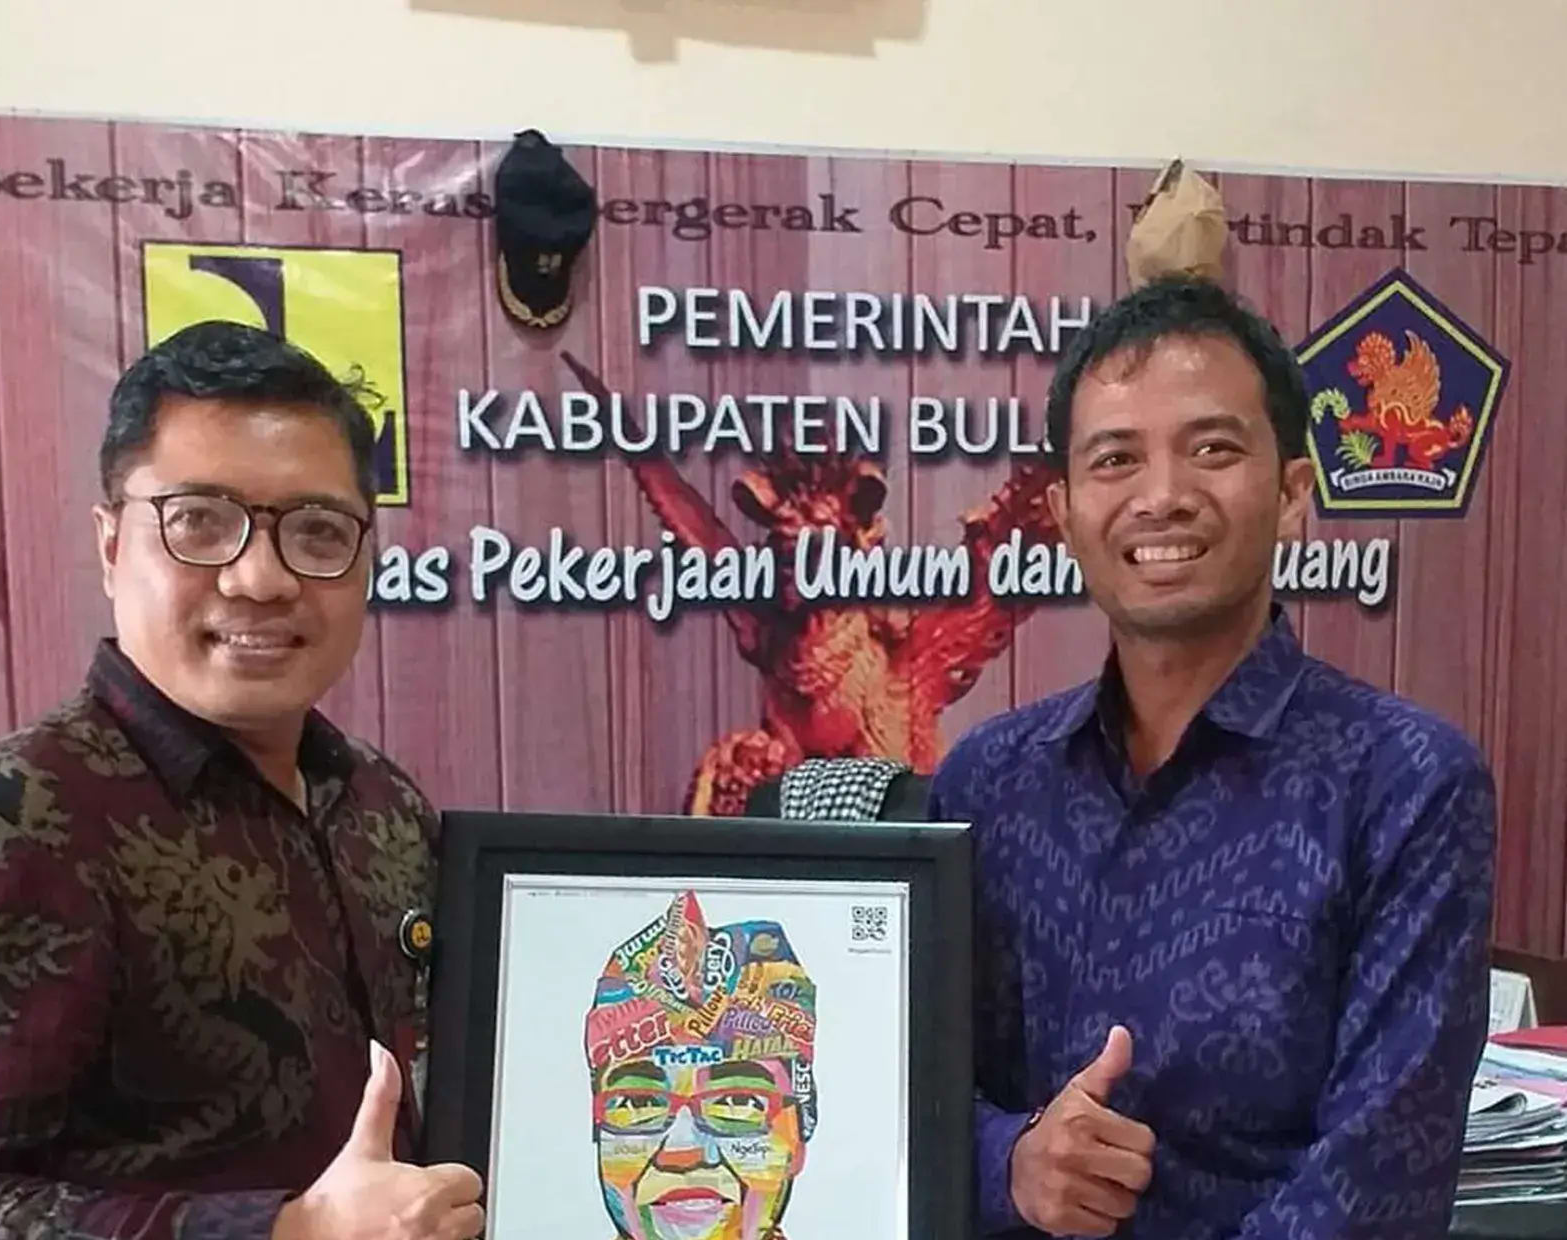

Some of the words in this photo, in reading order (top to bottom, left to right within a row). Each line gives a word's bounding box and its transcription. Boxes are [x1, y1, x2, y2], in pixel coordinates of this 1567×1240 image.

[273, 168, 496, 219] Keras
[598, 192, 864, 242] ergerak
[888, 195, 1098, 251] Cepat,
[637, 285, 1091, 353] PEMERINTAH
[457, 387, 882, 454] KABUPATEN
[909, 395, 1055, 454] BUL
[469, 525, 775, 623] Pekerjaan
[792, 525, 971, 602] Umum
[1272, 537, 1390, 608] uang
